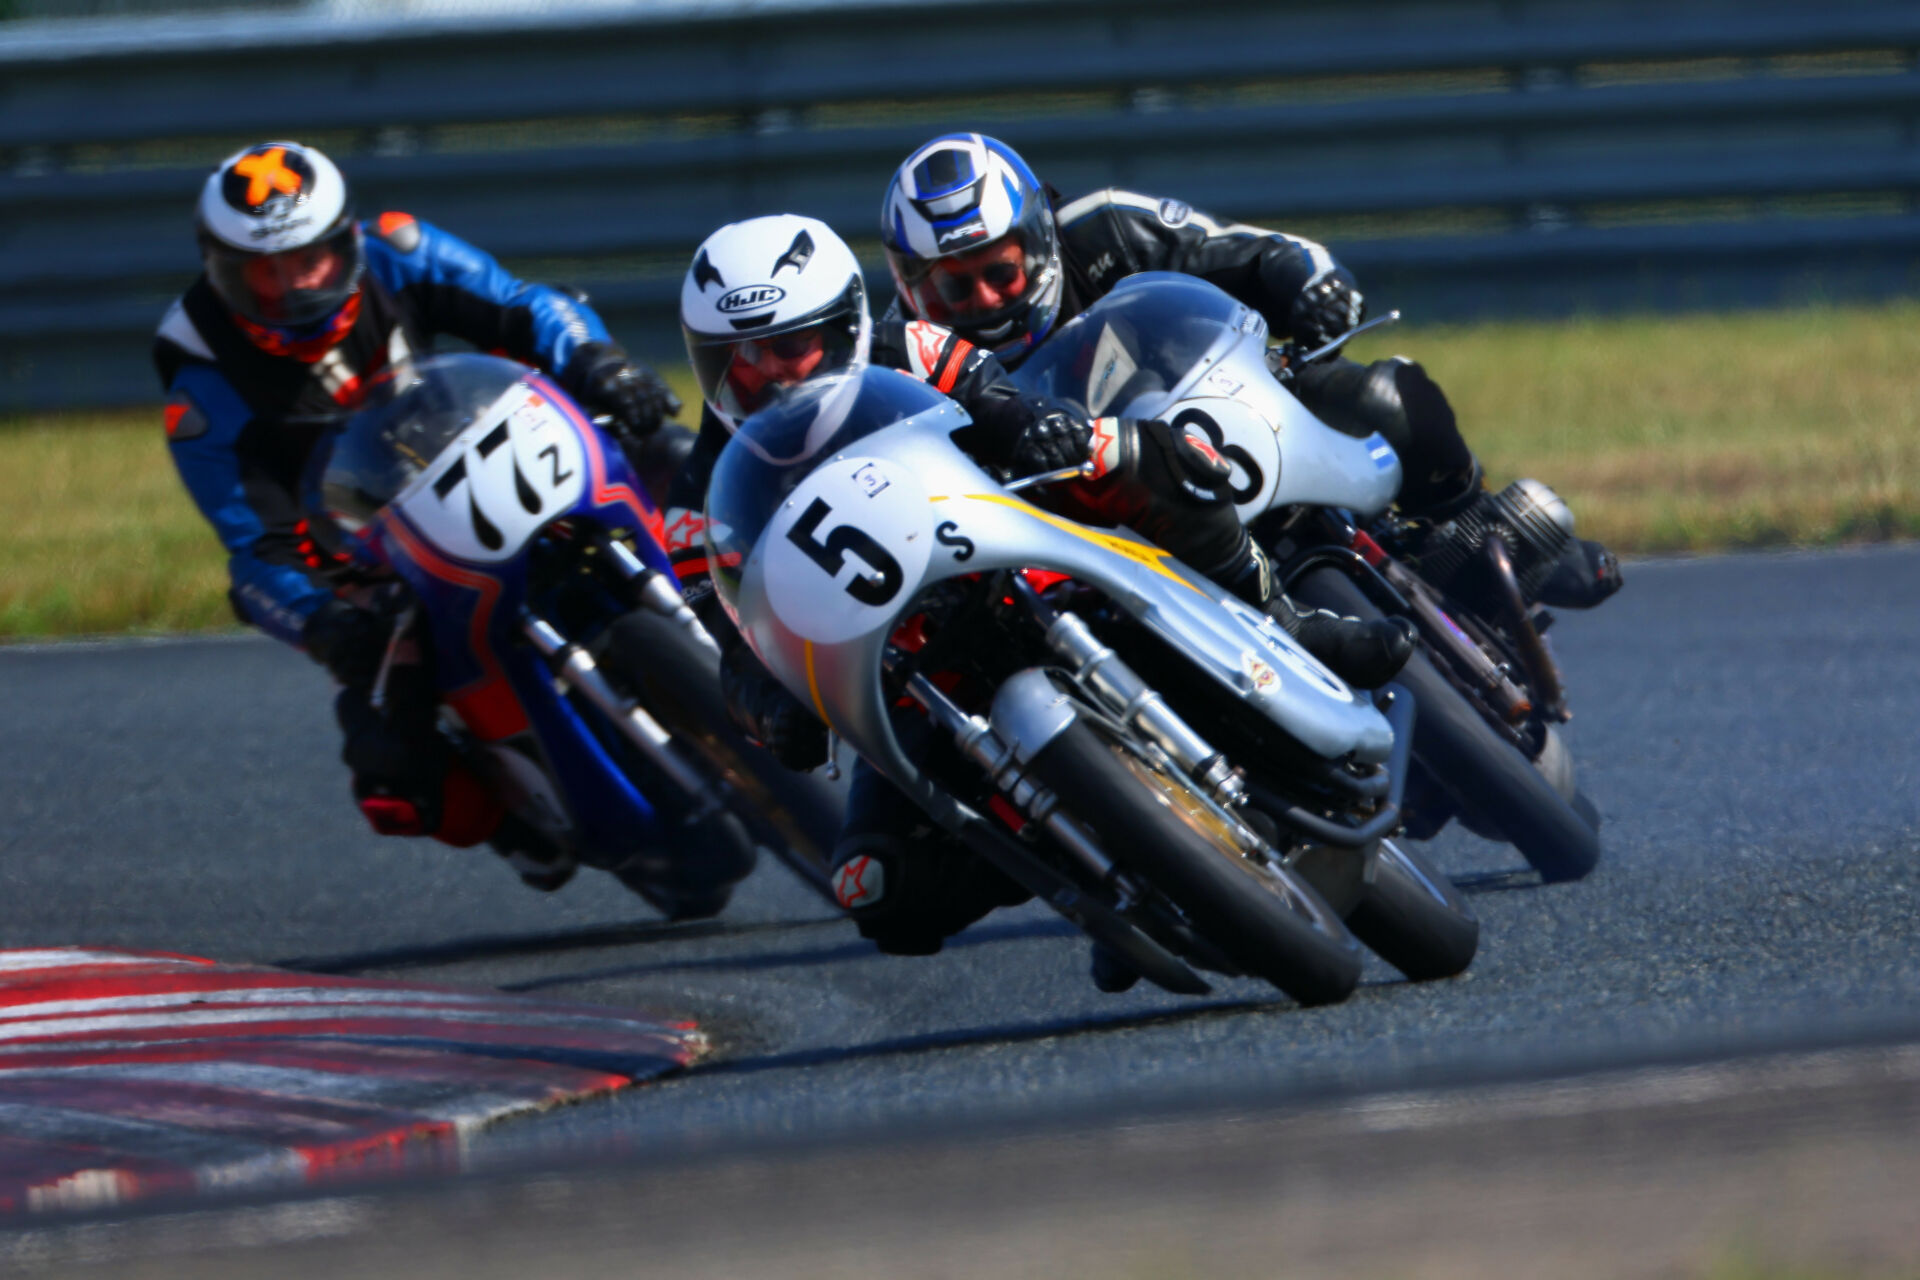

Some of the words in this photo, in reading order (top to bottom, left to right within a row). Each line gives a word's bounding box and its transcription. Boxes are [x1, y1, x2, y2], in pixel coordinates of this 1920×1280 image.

[725, 289, 777, 309] HJC
[434, 417, 543, 552] 77
[785, 496, 904, 607] 5
[935, 520, 975, 562] S
